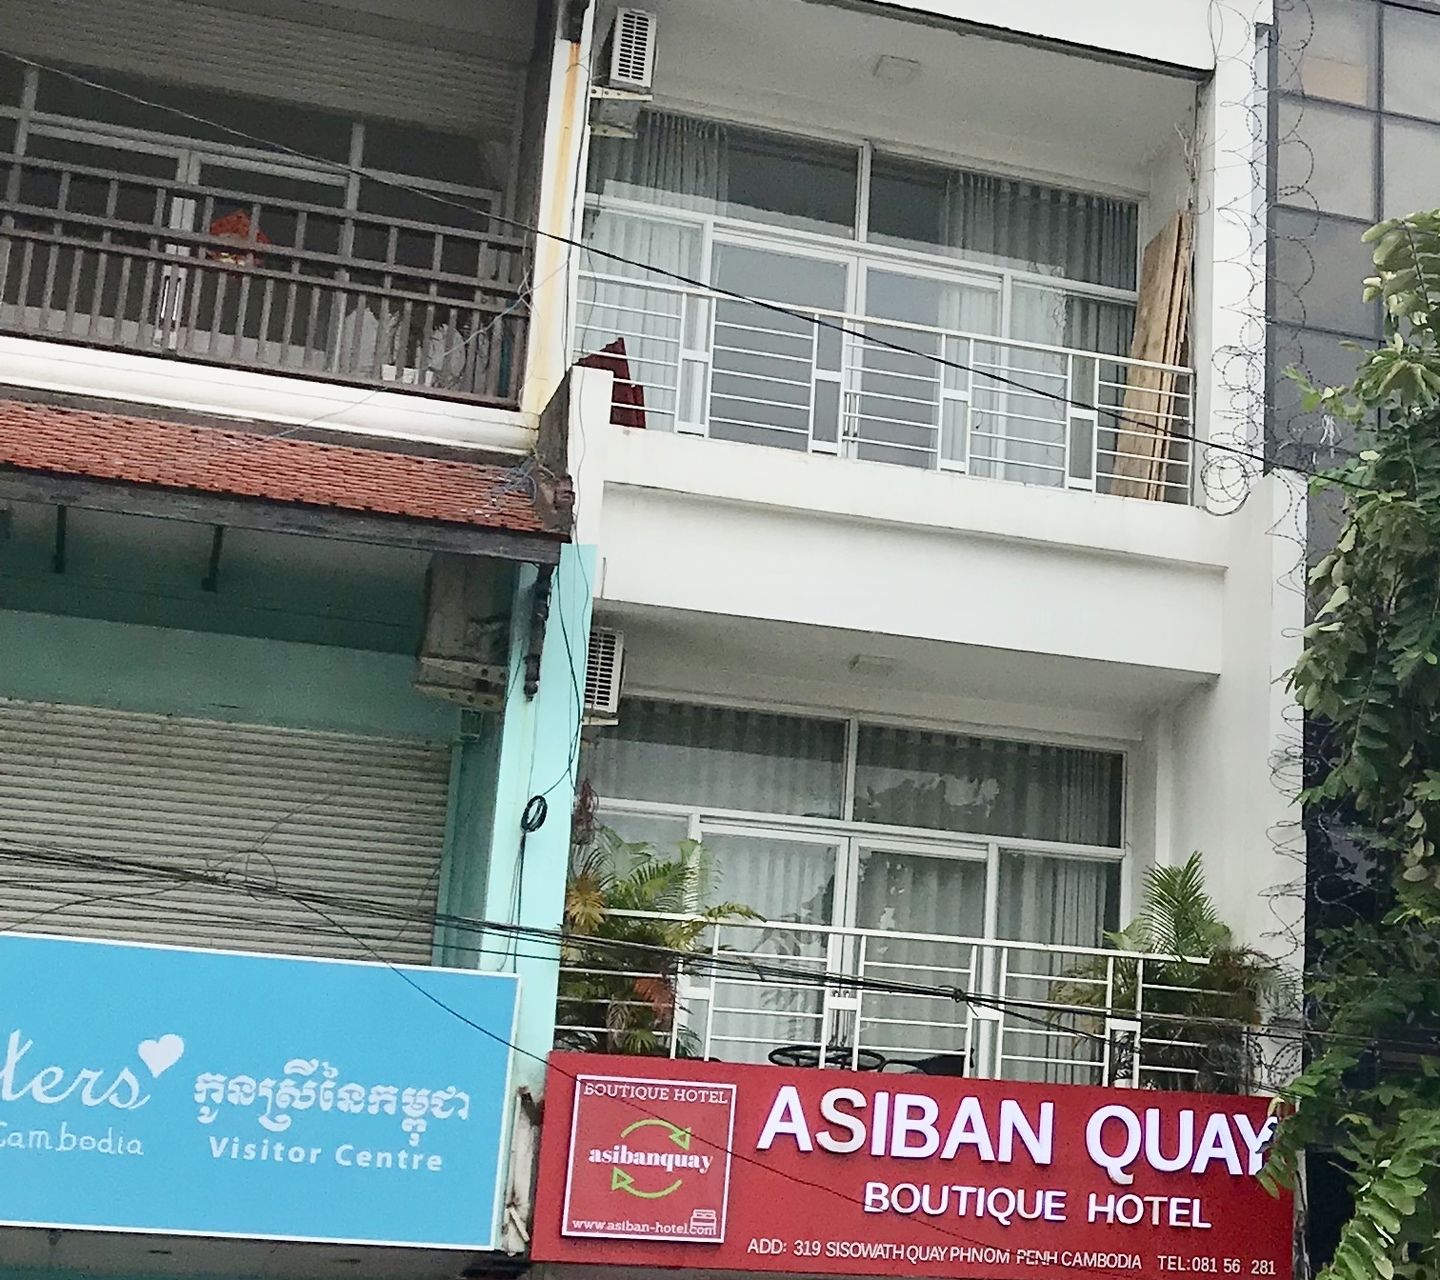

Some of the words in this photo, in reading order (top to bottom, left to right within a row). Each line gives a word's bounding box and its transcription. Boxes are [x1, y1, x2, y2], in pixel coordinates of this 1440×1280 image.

[584, 1082, 669, 1102] BOUTIQUE
[674, 1088, 728, 1105] HOTEL
[208, 1135, 322, 1164] Visitor
[335, 1144, 444, 1171] Centre
[756, 1085, 1054, 1165] ASIBAN
[1086, 1104, 1279, 1185] QUAY
[588, 1144, 714, 1175] asibanquay
[864, 1181, 1067, 1226] BOUTIQUE
[1087, 1192, 1212, 1229] HOTEL
[747, 1238, 787, 1255] ADD:
[793, 1239, 821, 1257] 319
[825, 1241, 904, 1261] SISOWATH
[906, 1244, 948, 1264] QUAY
[949, 1246, 1010, 1264] PHNOM
[1016, 1249, 1058, 1266] PENH
[1061, 1251, 1142, 1270] CAMBODIA
[1251, 1260, 1276, 1275] 281
